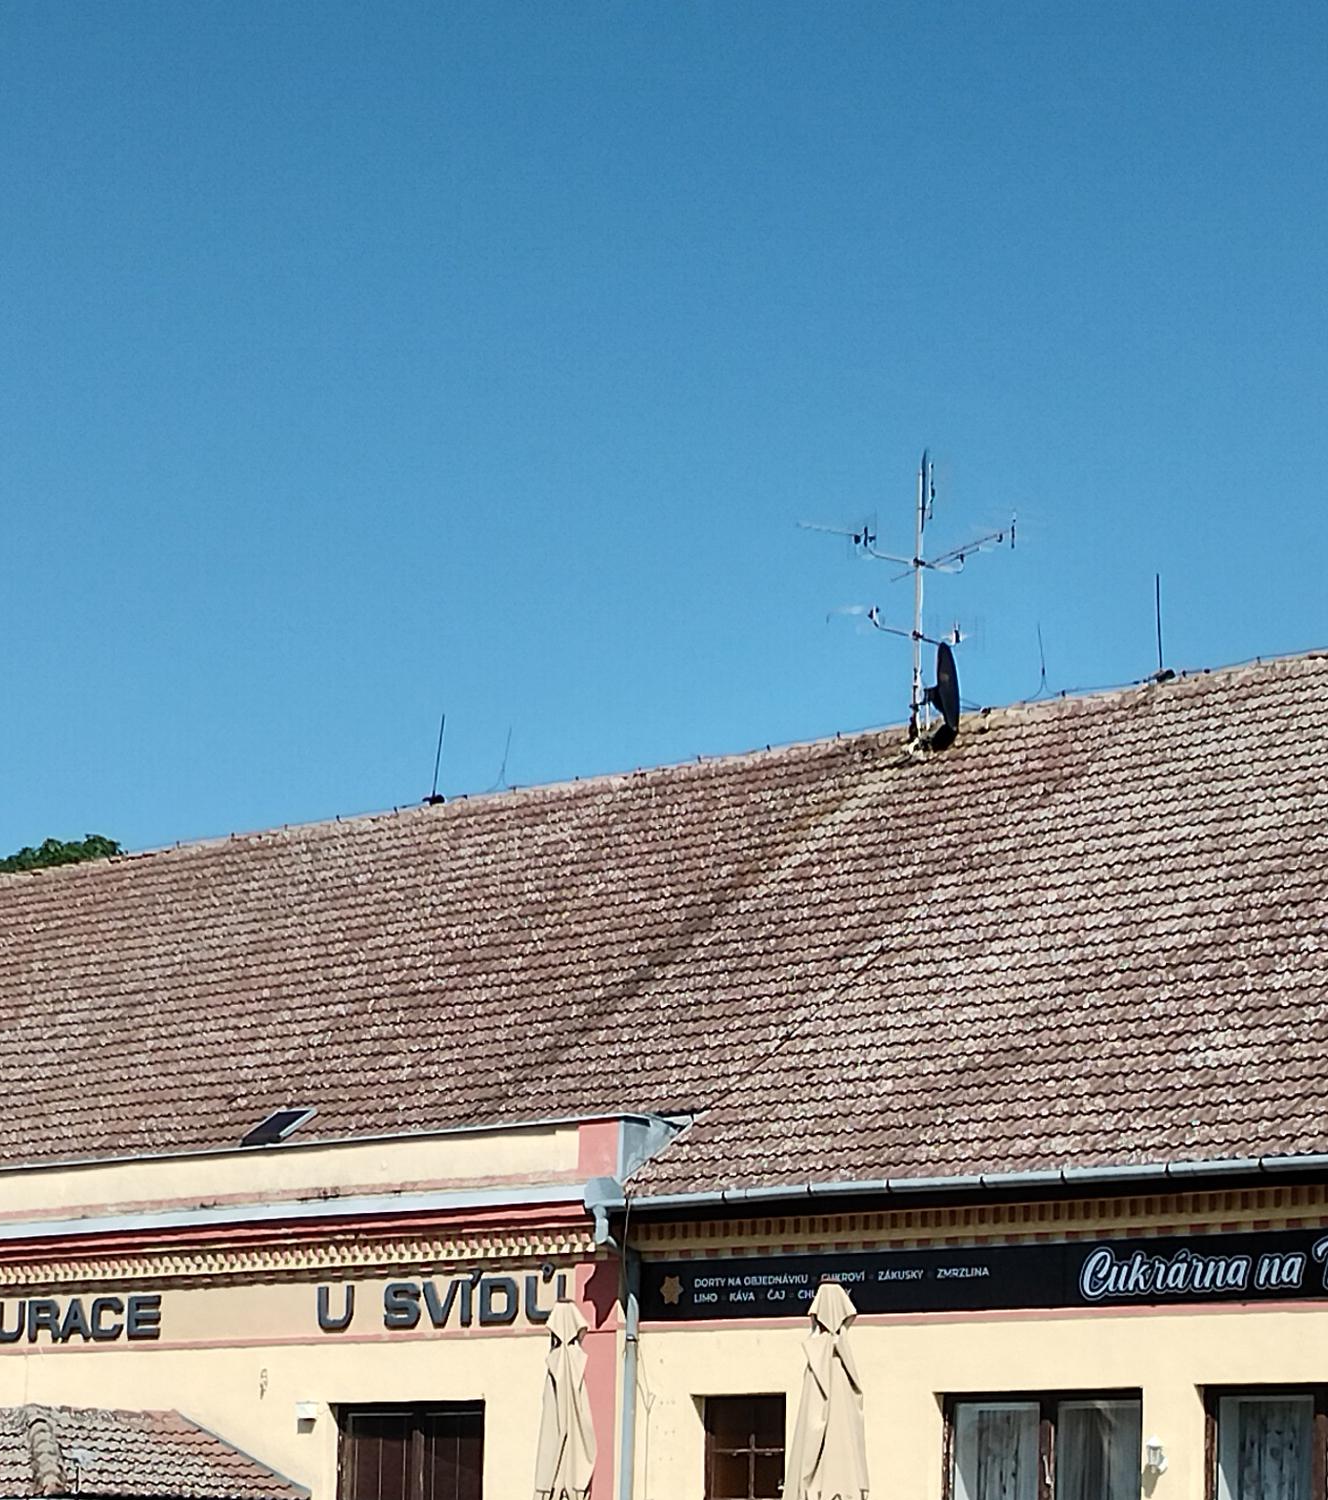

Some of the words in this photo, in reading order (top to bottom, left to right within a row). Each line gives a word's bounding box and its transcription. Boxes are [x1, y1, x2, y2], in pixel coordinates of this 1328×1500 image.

[694, 1277, 725, 1288] DORTY
[728, 1277, 741, 1287] NA
[743, 1273, 809, 1286] OBJEDNÁVKU
[877, 1269, 923, 1281] ZÁKUSKY
[937, 1267, 990, 1279] ZMRZLINA
[1080, 1248, 1249, 1299] Cukrárna
[1257, 1253, 1304, 1287] na
[317, 1285, 355, 1333] U
[694, 1293, 718, 1303] LIMO
[729, 1290, 755, 1302] KÁVA
[767, 1289, 786, 1300] ČAJ
